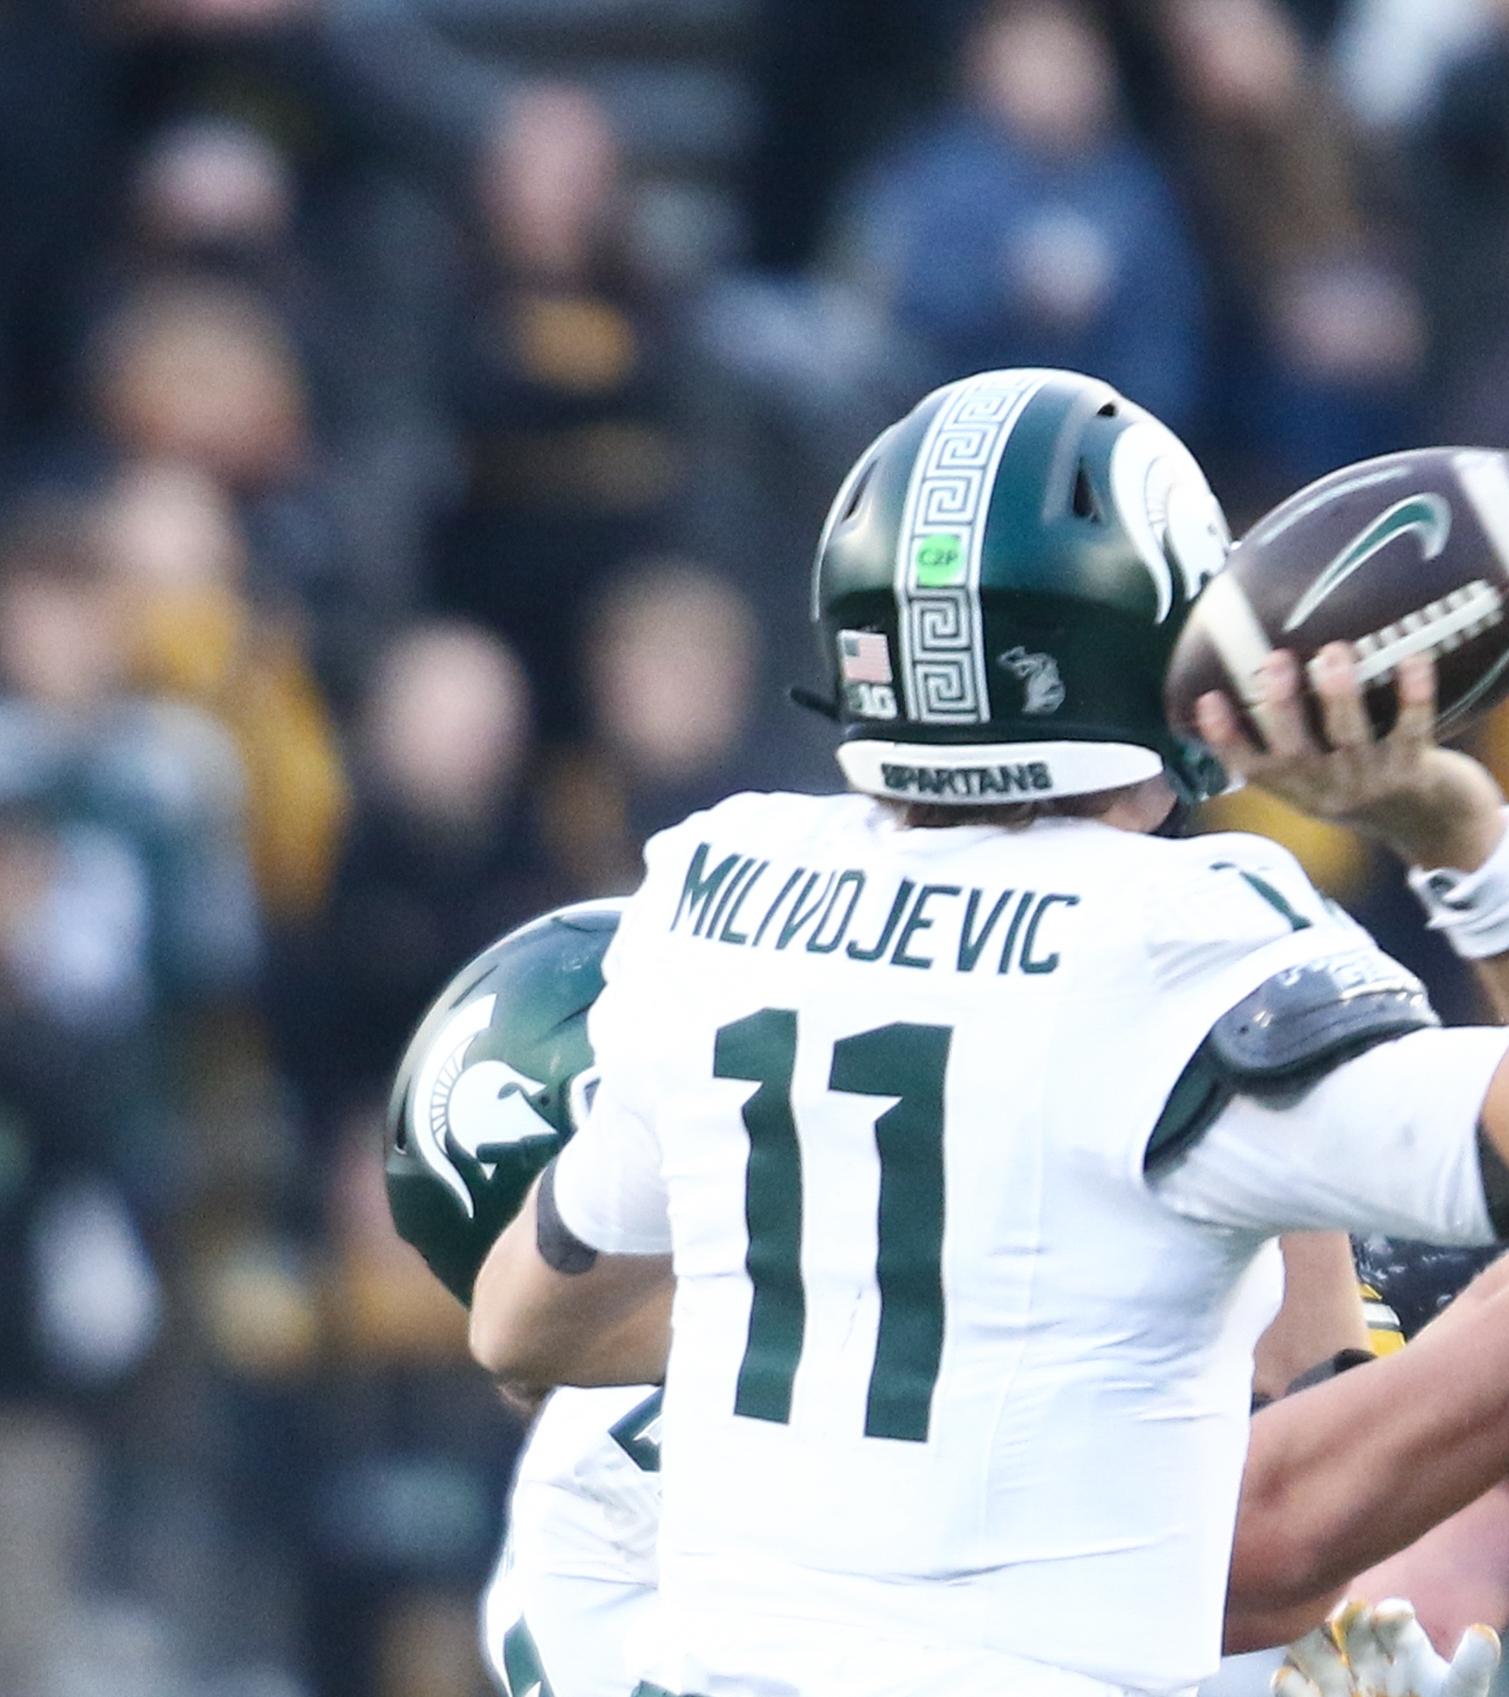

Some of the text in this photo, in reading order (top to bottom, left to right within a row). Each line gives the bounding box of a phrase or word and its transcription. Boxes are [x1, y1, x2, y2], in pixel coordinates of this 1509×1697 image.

[880, 762, 1053, 796] SPARTANS
[670, 842, 1081, 975] MILIVOJEVIC
[712, 1007, 954, 1443] 11
